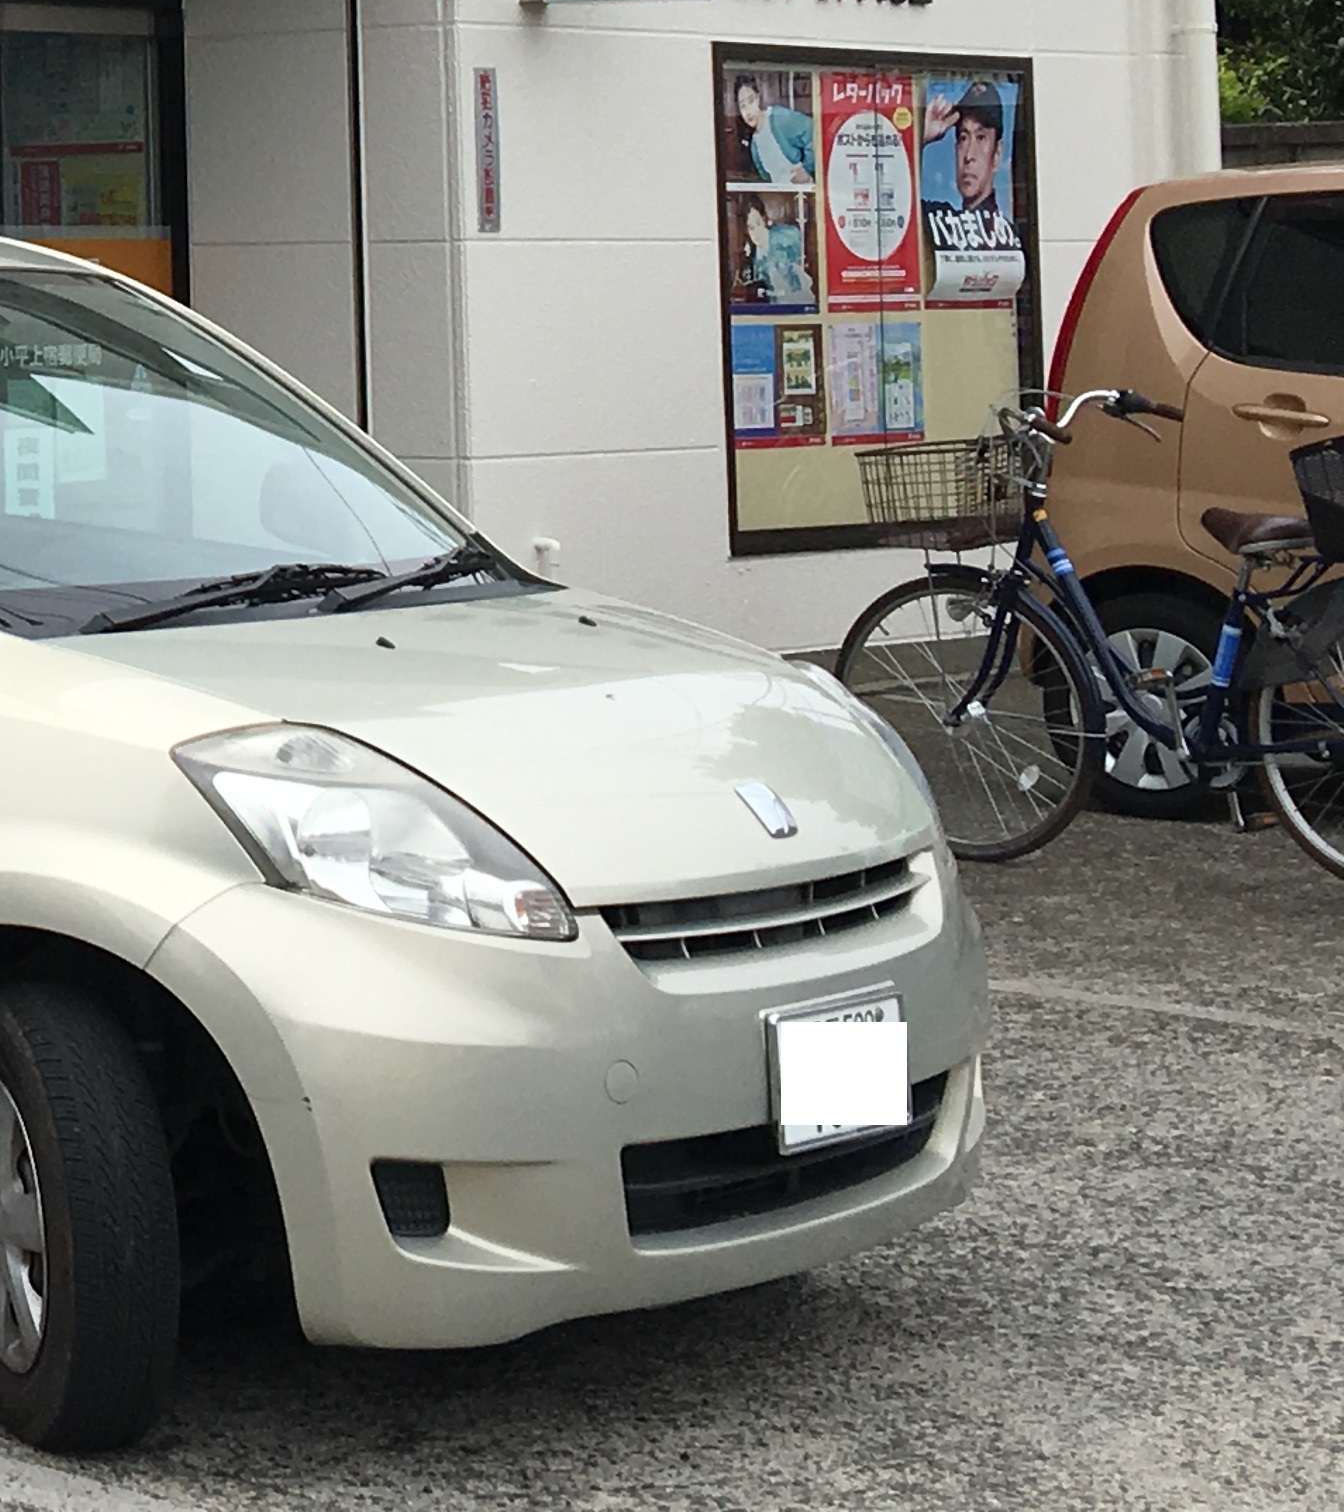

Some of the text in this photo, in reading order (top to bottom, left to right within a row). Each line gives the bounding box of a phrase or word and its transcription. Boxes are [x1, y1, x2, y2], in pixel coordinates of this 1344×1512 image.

[833, 81, 903, 104] レターパック
